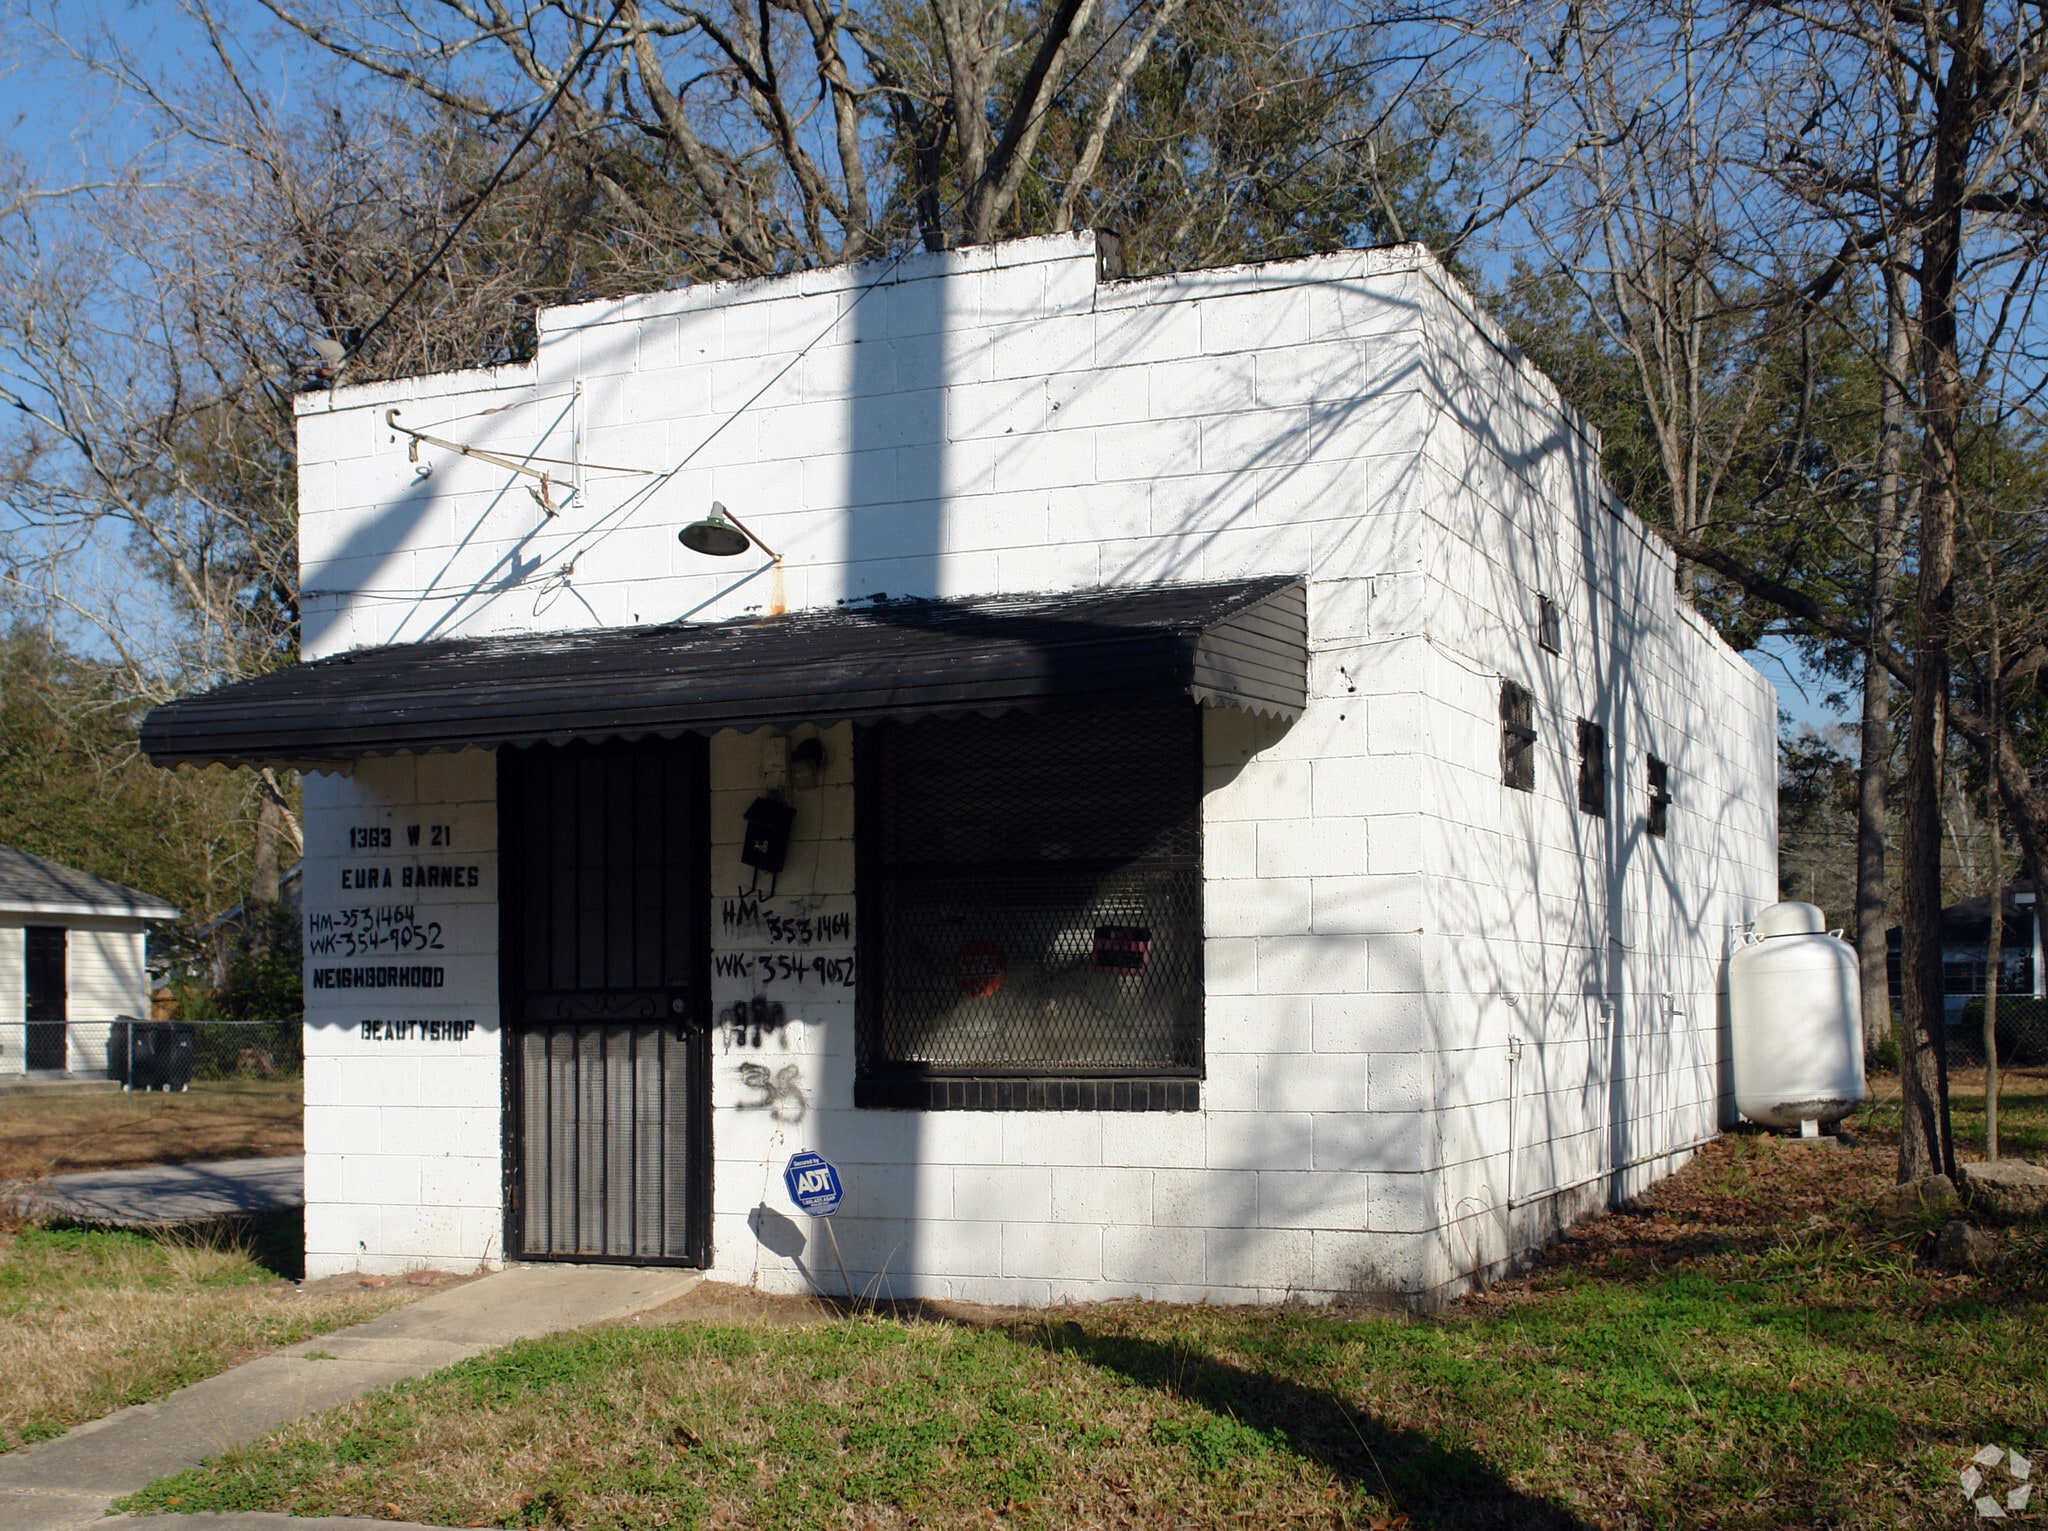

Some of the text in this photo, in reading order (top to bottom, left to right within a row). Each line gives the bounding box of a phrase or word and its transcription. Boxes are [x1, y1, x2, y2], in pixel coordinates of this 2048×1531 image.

[407, 825, 420, 846] W
[431, 825, 450, 846] 21
[342, 866, 479, 889] EURA BARNES
[313, 966, 444, 988] NEIGHBORHOOD
[798, 1168, 830, 1194] ADT
